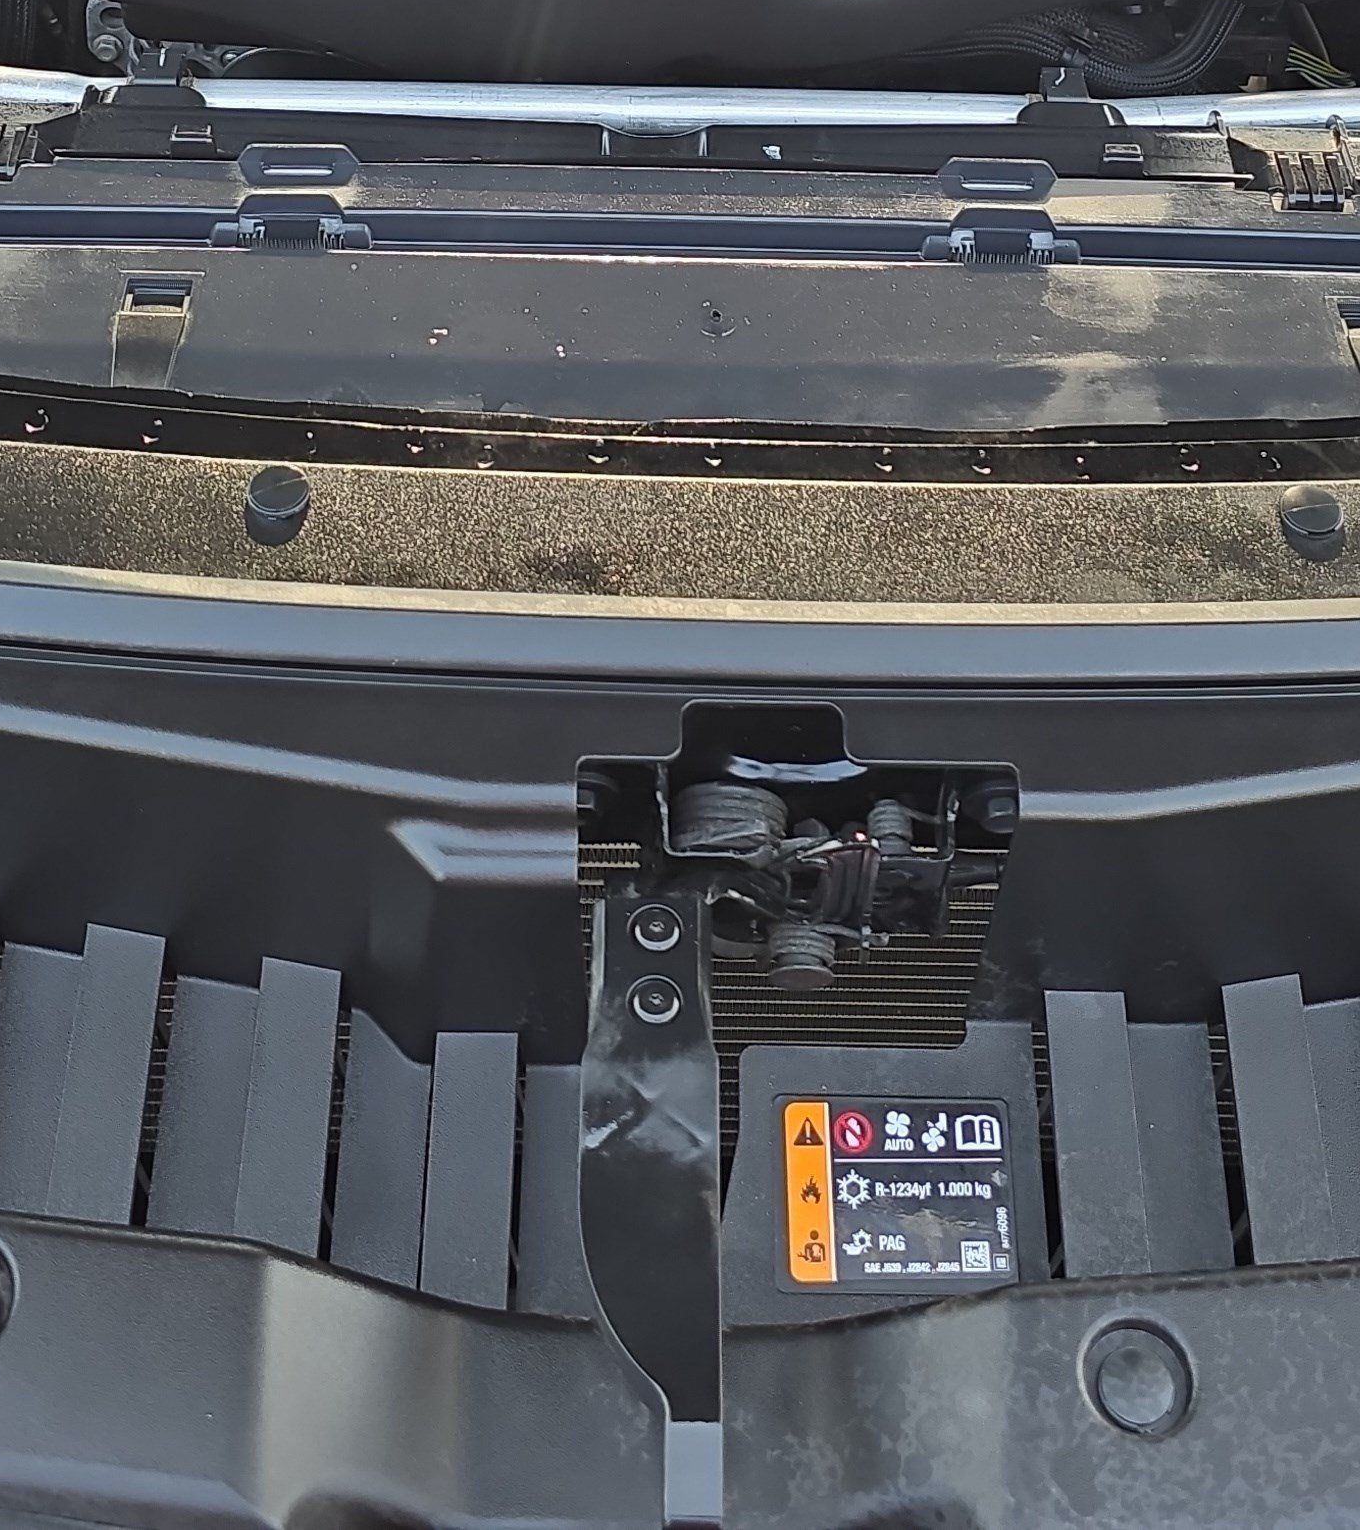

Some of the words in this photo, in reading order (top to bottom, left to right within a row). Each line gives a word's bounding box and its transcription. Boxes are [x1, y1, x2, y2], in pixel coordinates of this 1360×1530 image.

[884, 1137, 914, 1151] AUTO
[875, 1183, 932, 1200] R-1234yf
[938, 1182, 973, 1196] 1.000
[974, 1182, 992, 1199] kg
[878, 1234, 907, 1251] PAG
[864, 1262, 881, 1273] SAE
